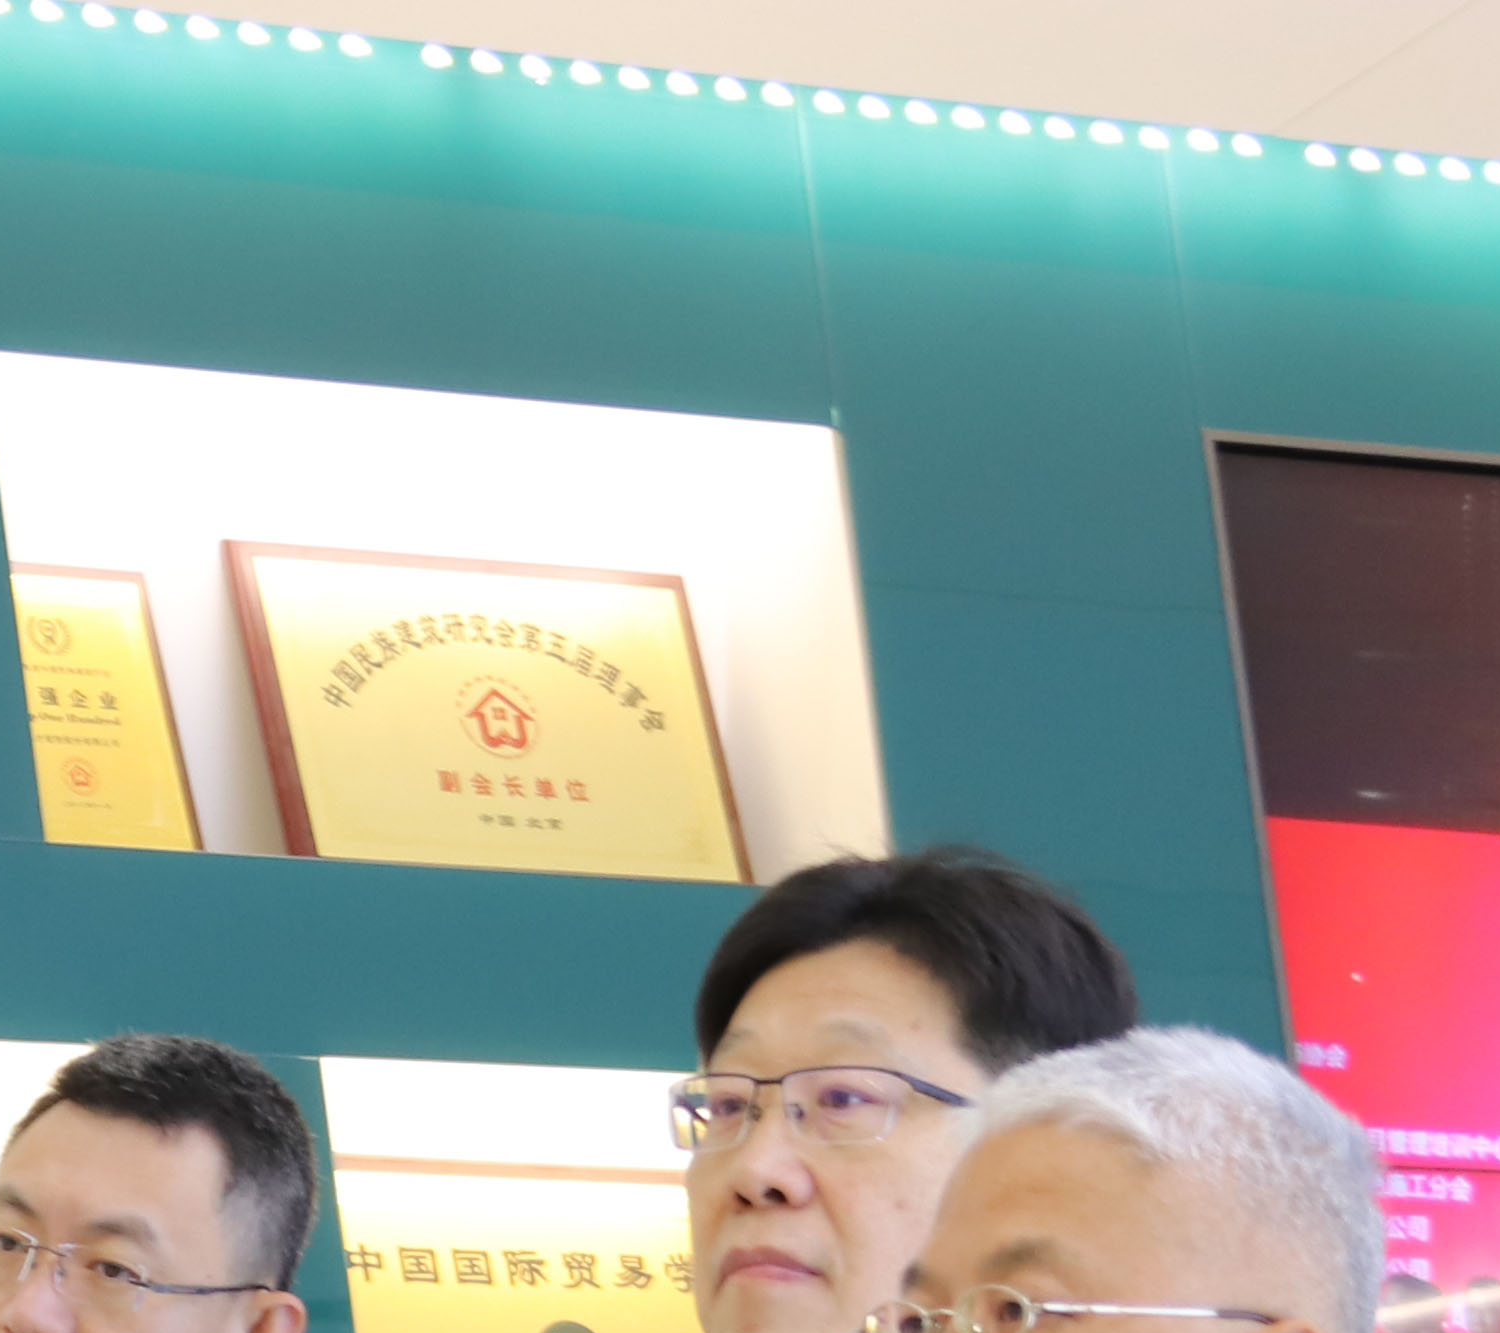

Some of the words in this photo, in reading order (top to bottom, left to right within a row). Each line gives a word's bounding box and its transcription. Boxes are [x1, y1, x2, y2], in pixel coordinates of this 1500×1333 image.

[437, 769, 592, 803] 副会长单位
